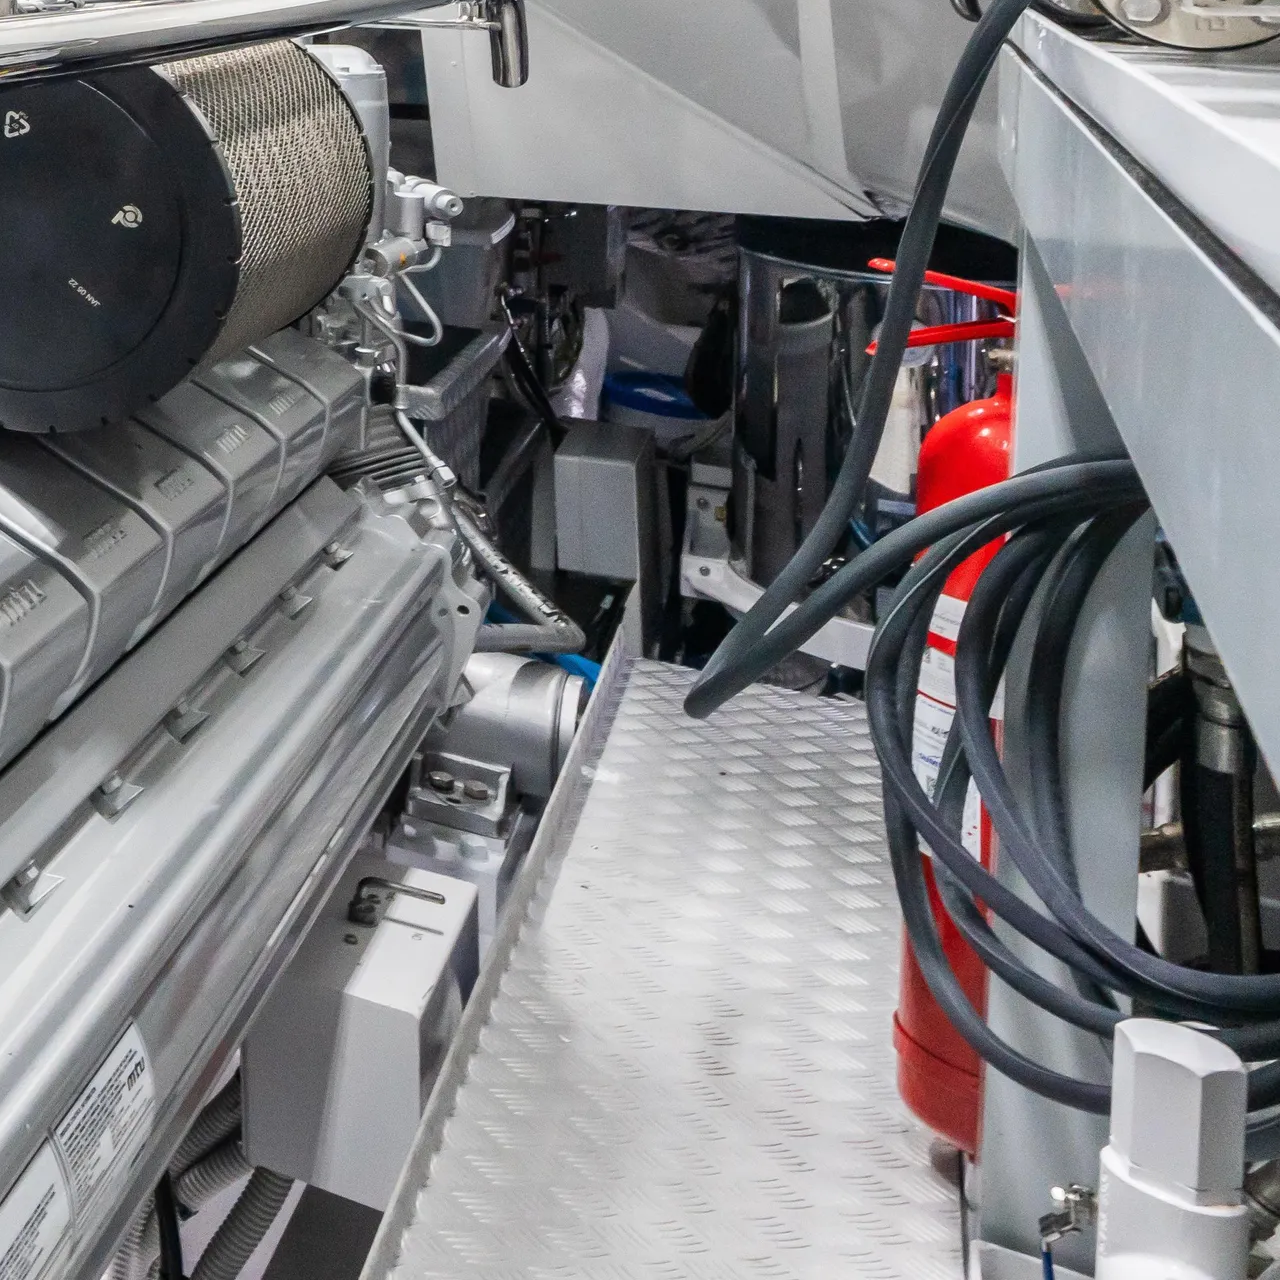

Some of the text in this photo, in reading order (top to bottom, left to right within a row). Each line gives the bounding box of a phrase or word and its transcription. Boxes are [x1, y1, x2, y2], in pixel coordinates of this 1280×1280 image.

[68, 278, 79, 288] 22
[86, 293, 101, 308] JAN
[216, 424, 249, 455] mtu
[126, 1056, 146, 1091] mtu
